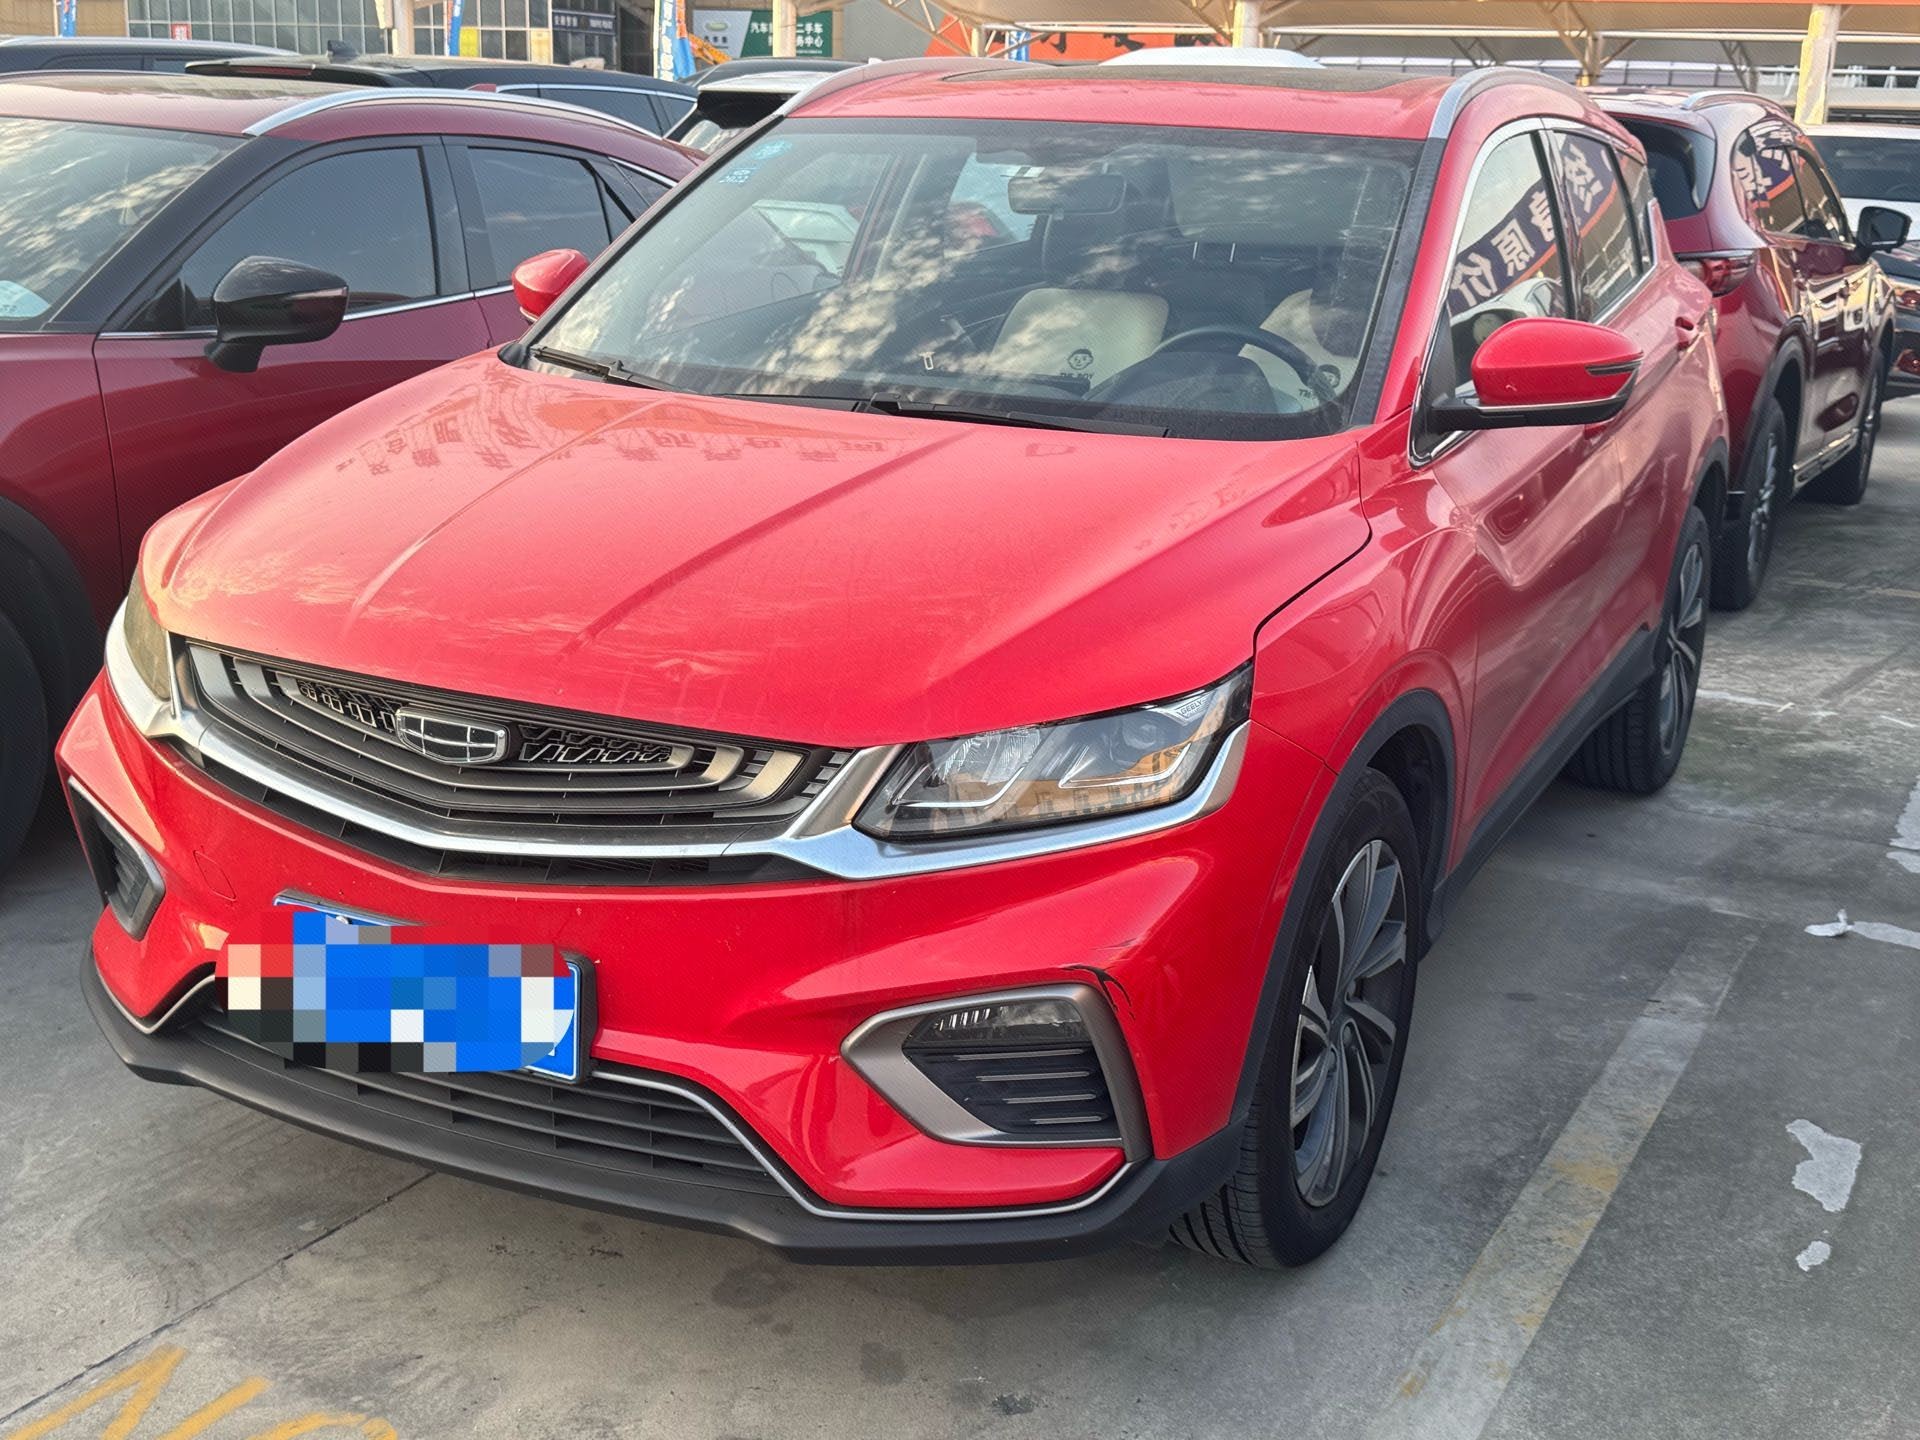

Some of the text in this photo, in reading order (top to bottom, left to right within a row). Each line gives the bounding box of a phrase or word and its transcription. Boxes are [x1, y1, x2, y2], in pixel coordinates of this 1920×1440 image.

[796, 23, 823, 34] 二手车
[1180, 699, 1203, 715] GEELY
